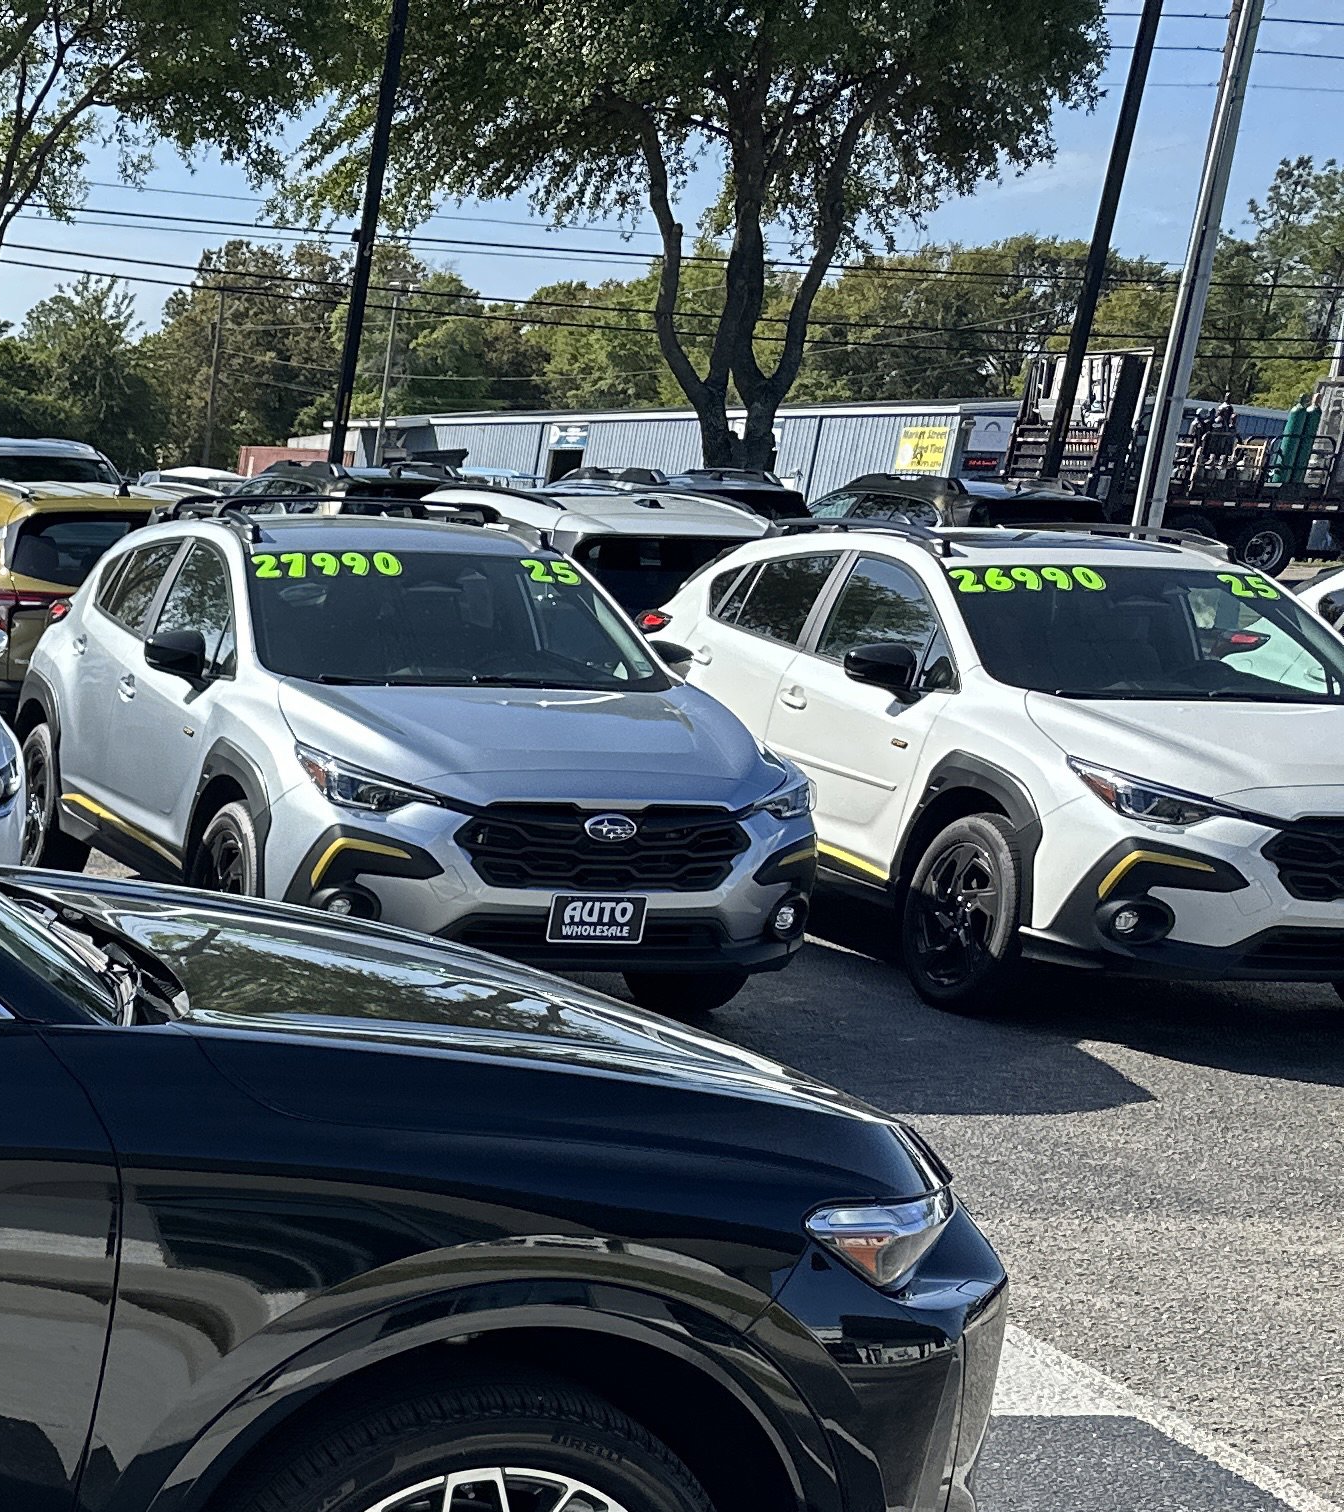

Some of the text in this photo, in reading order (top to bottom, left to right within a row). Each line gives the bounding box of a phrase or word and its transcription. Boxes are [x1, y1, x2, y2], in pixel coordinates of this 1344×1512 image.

[251, 552, 582, 585] 27990 25
[948, 566, 1280, 600] 26990 25
[563, 901, 634, 924] AUTO
[561, 925, 630, 937] WHOLESALE
